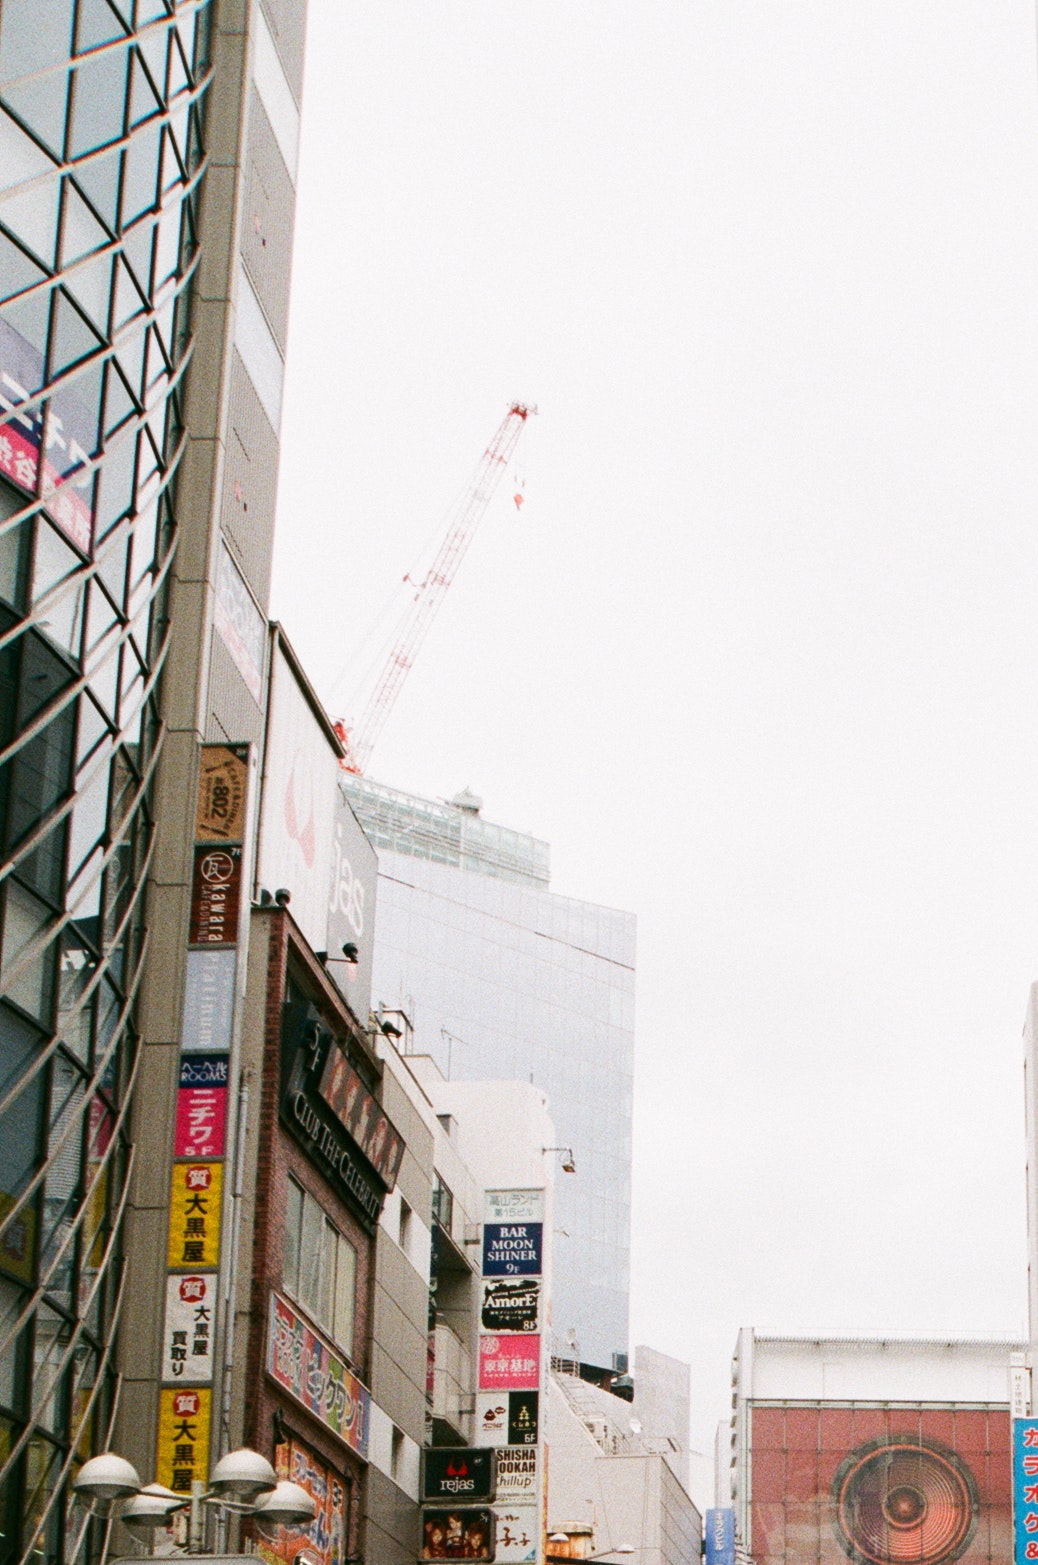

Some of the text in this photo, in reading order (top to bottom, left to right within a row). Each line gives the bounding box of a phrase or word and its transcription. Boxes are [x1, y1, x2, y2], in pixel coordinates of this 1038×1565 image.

[181, 1193, 208, 1263] 大黒屋
[500, 1227, 527, 1238] BAR
[491, 1239, 534, 1250] MOON
[487, 1250, 538, 1262] SHINER
[505, 1263, 521, 1275] 9F
[192, 1305, 211, 1357] 大黒屋
[170, 1331, 188, 1377] 買取り
[170, 1420, 198, 1493] 大黒屋
[498, 1462, 536, 1474] OOKAH
[440, 1478, 475, 1493] rejas
